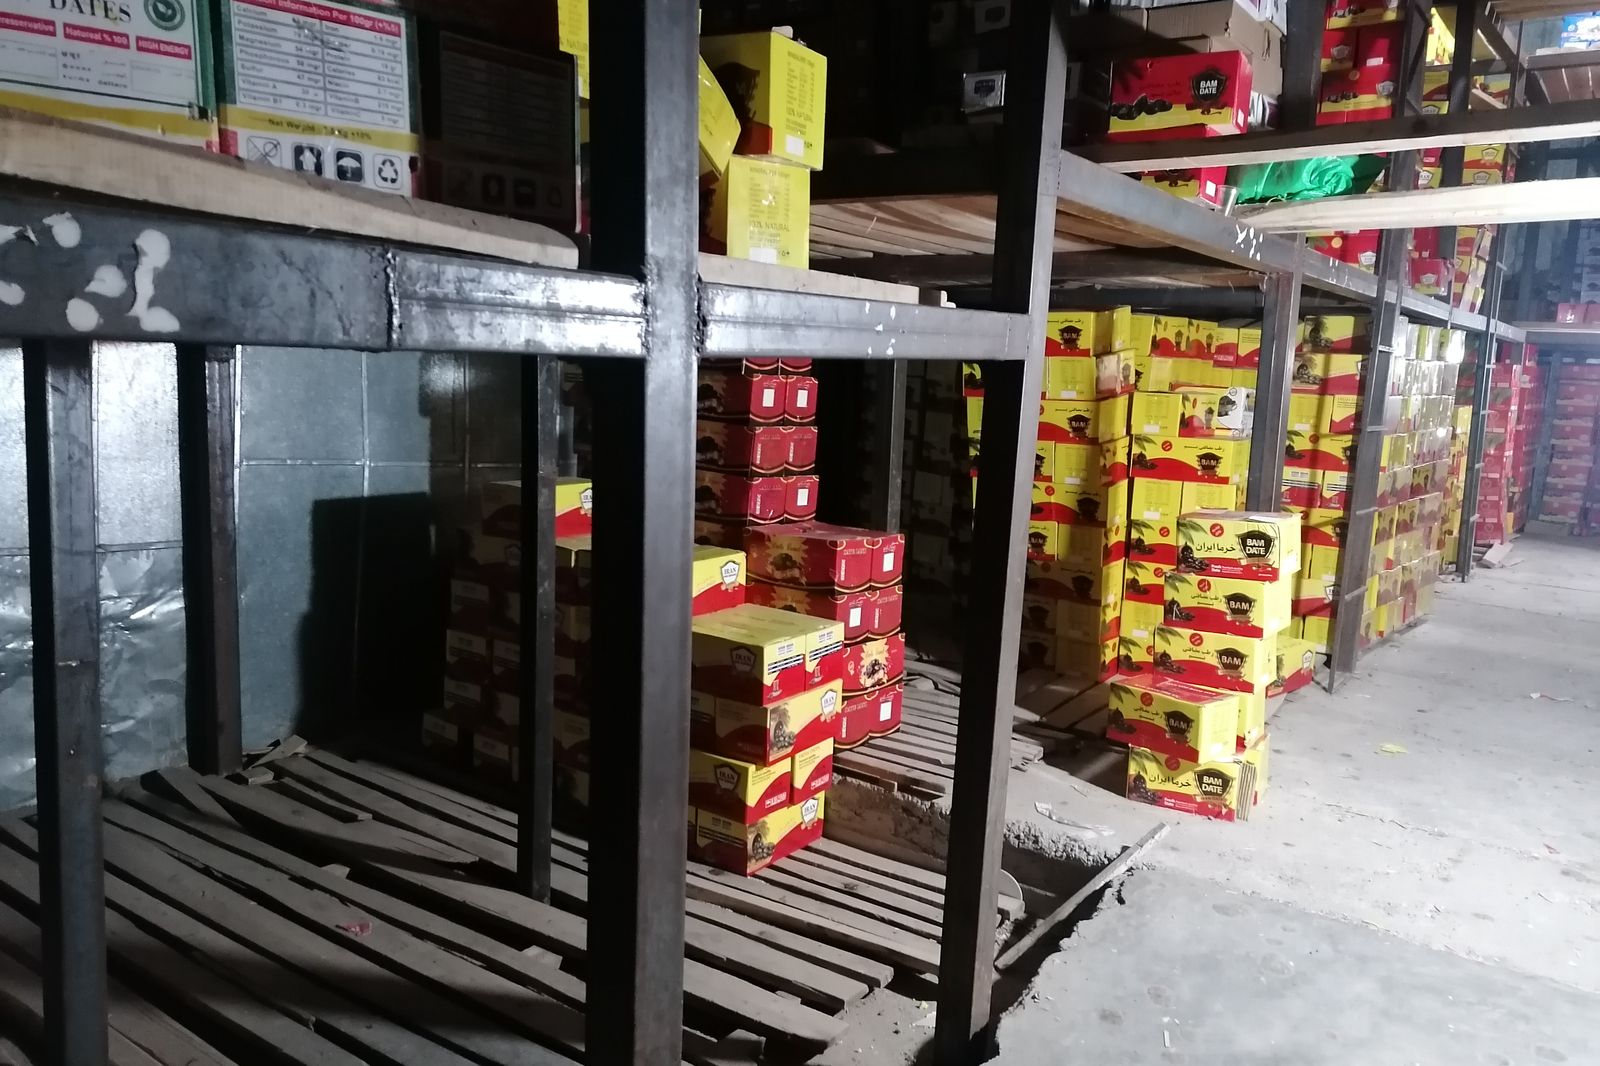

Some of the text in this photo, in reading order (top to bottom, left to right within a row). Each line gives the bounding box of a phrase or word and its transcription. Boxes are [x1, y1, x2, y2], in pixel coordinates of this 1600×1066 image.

[50, 0, 132, 23] DATES
[278, 0, 331, 17] Information
[332, 6, 348, 21] Per
[349, 12, 374, 29] 100gr
[112, 35, 128, 45] 100
[137, 39, 190, 56] HIGH ENERGY
[1200, 79, 1218, 88] BAM
[1199, 87, 1217, 96] DATE
[764, 221, 790, 232] NATURAL
[1062, 332, 1078, 340] BAM
[1071, 420, 1087, 429] BAM
[1201, 457, 1218, 467] BAM
[1246, 538, 1265, 546] BAM
[1195, 542, 1236, 554] خرما ایران
[1245, 546, 1266, 555] DATE
[724, 567, 737, 575] IRAN
[1229, 600, 1250, 611] BAM
[735, 653, 752, 663] IRAN
[1221, 655, 1241, 665] BAM
[1168, 718, 1188, 729] BAM
[719, 771, 736, 782] IRAN
[1148, 774, 1192, 789] خرما ایران
[1203, 775, 1223, 786] BAM
[1202, 783, 1223, 794] DATE
[804, 803, 816, 814] IRAN
